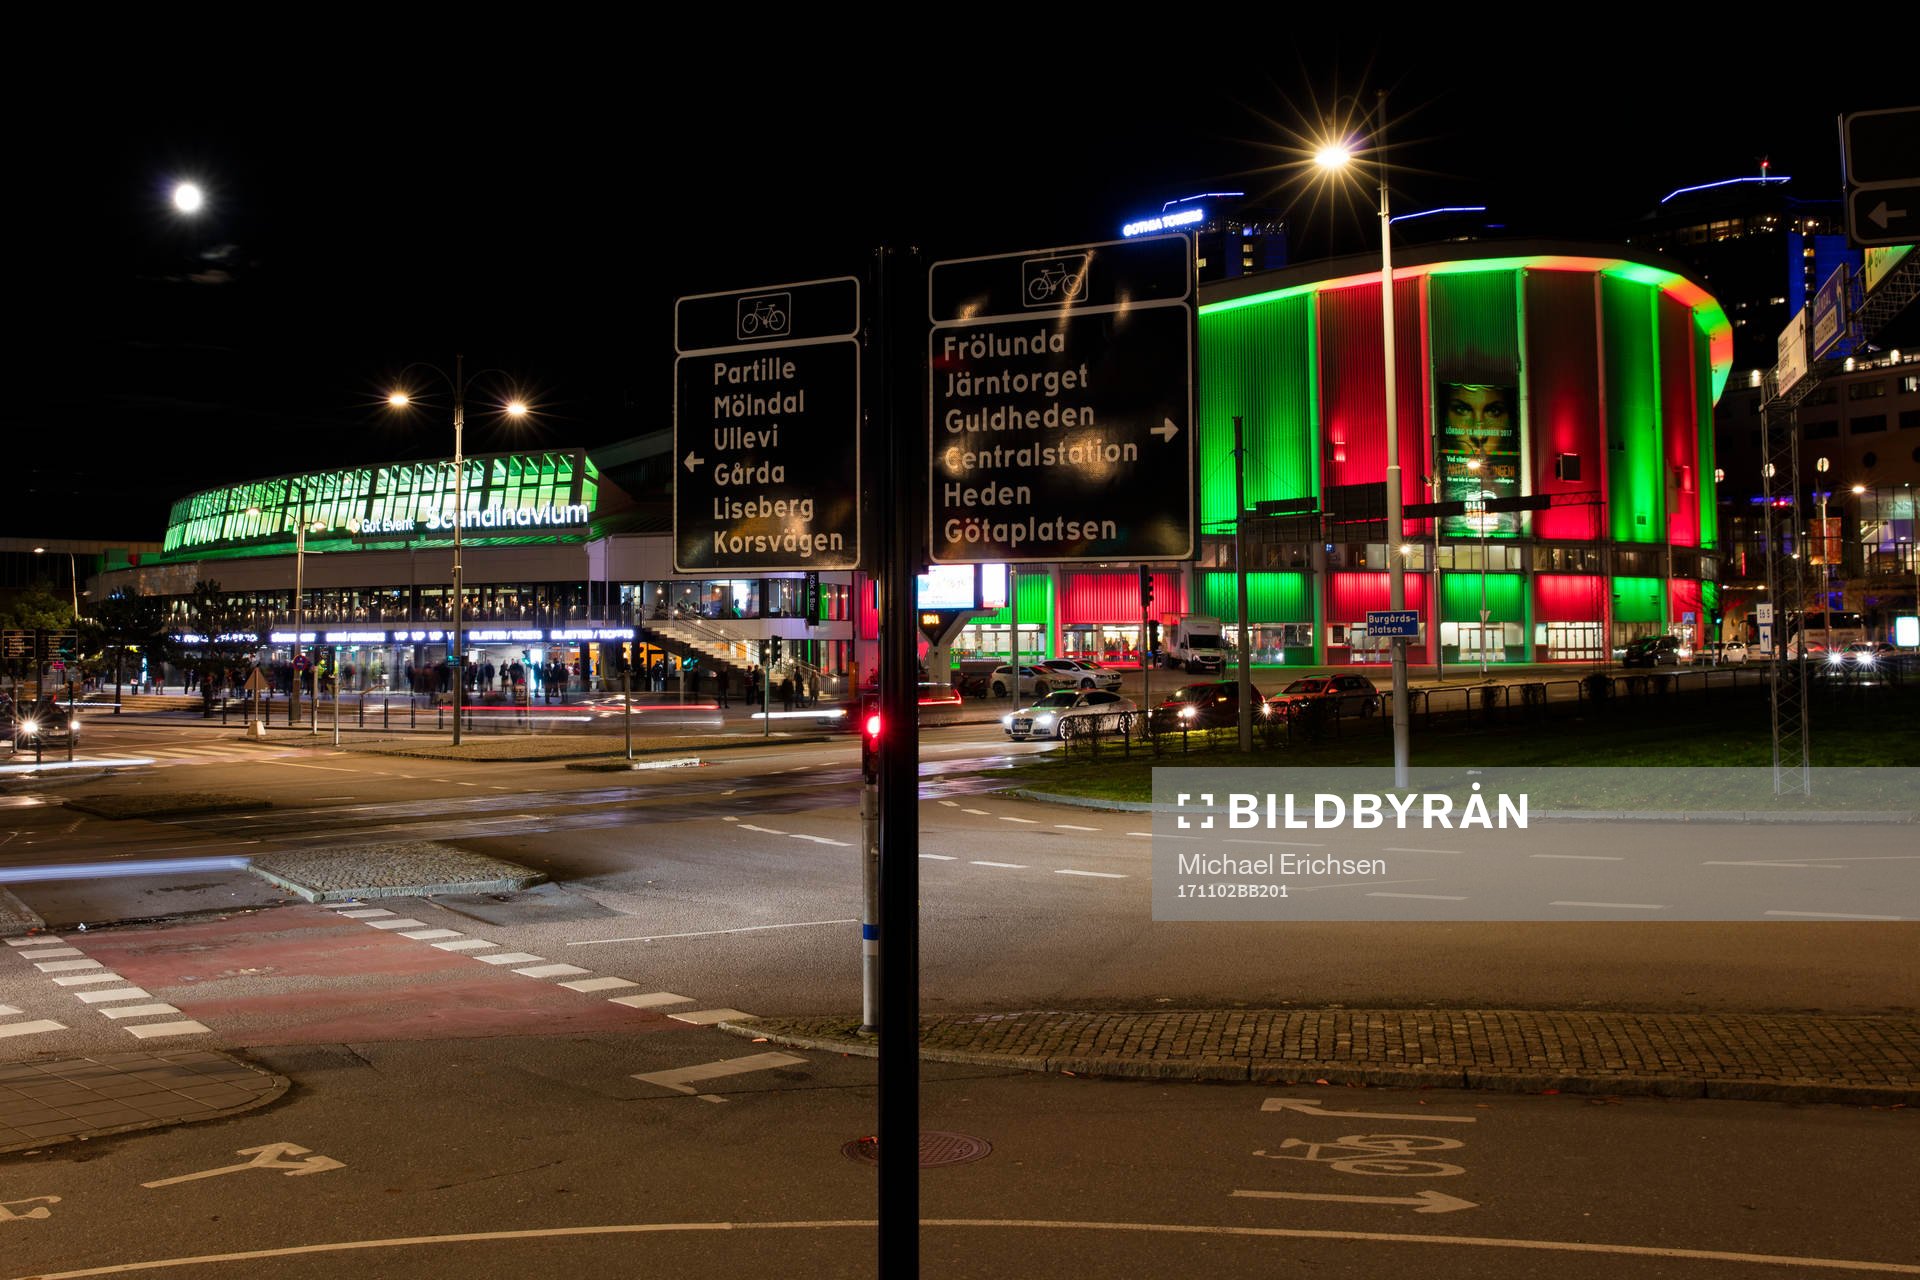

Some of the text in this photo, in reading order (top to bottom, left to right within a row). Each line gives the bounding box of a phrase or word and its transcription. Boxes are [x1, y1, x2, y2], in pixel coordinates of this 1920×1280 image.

[945, 328, 1067, 362] Frölunda
[713, 358, 797, 386] Partille
[945, 362, 1089, 399] Järntorget
[713, 389, 805, 419] Mölndal
[945, 404, 1096, 434] Guldheden
[713, 423, 778, 451] Ullevi
[944, 438, 1139, 473] Centralstation
[713, 461, 785, 486] Gårda
[713, 495, 815, 522] Liseberg
[944, 481, 1032, 508] Heden
[362, 515, 415, 534] Got Event
[425, 501, 589, 530] Scandinavium
[713, 525, 844, 559] Korsvägen
[944, 514, 1118, 549] Götaplatsen
[1368, 614, 1416, 625] Burgårds-
